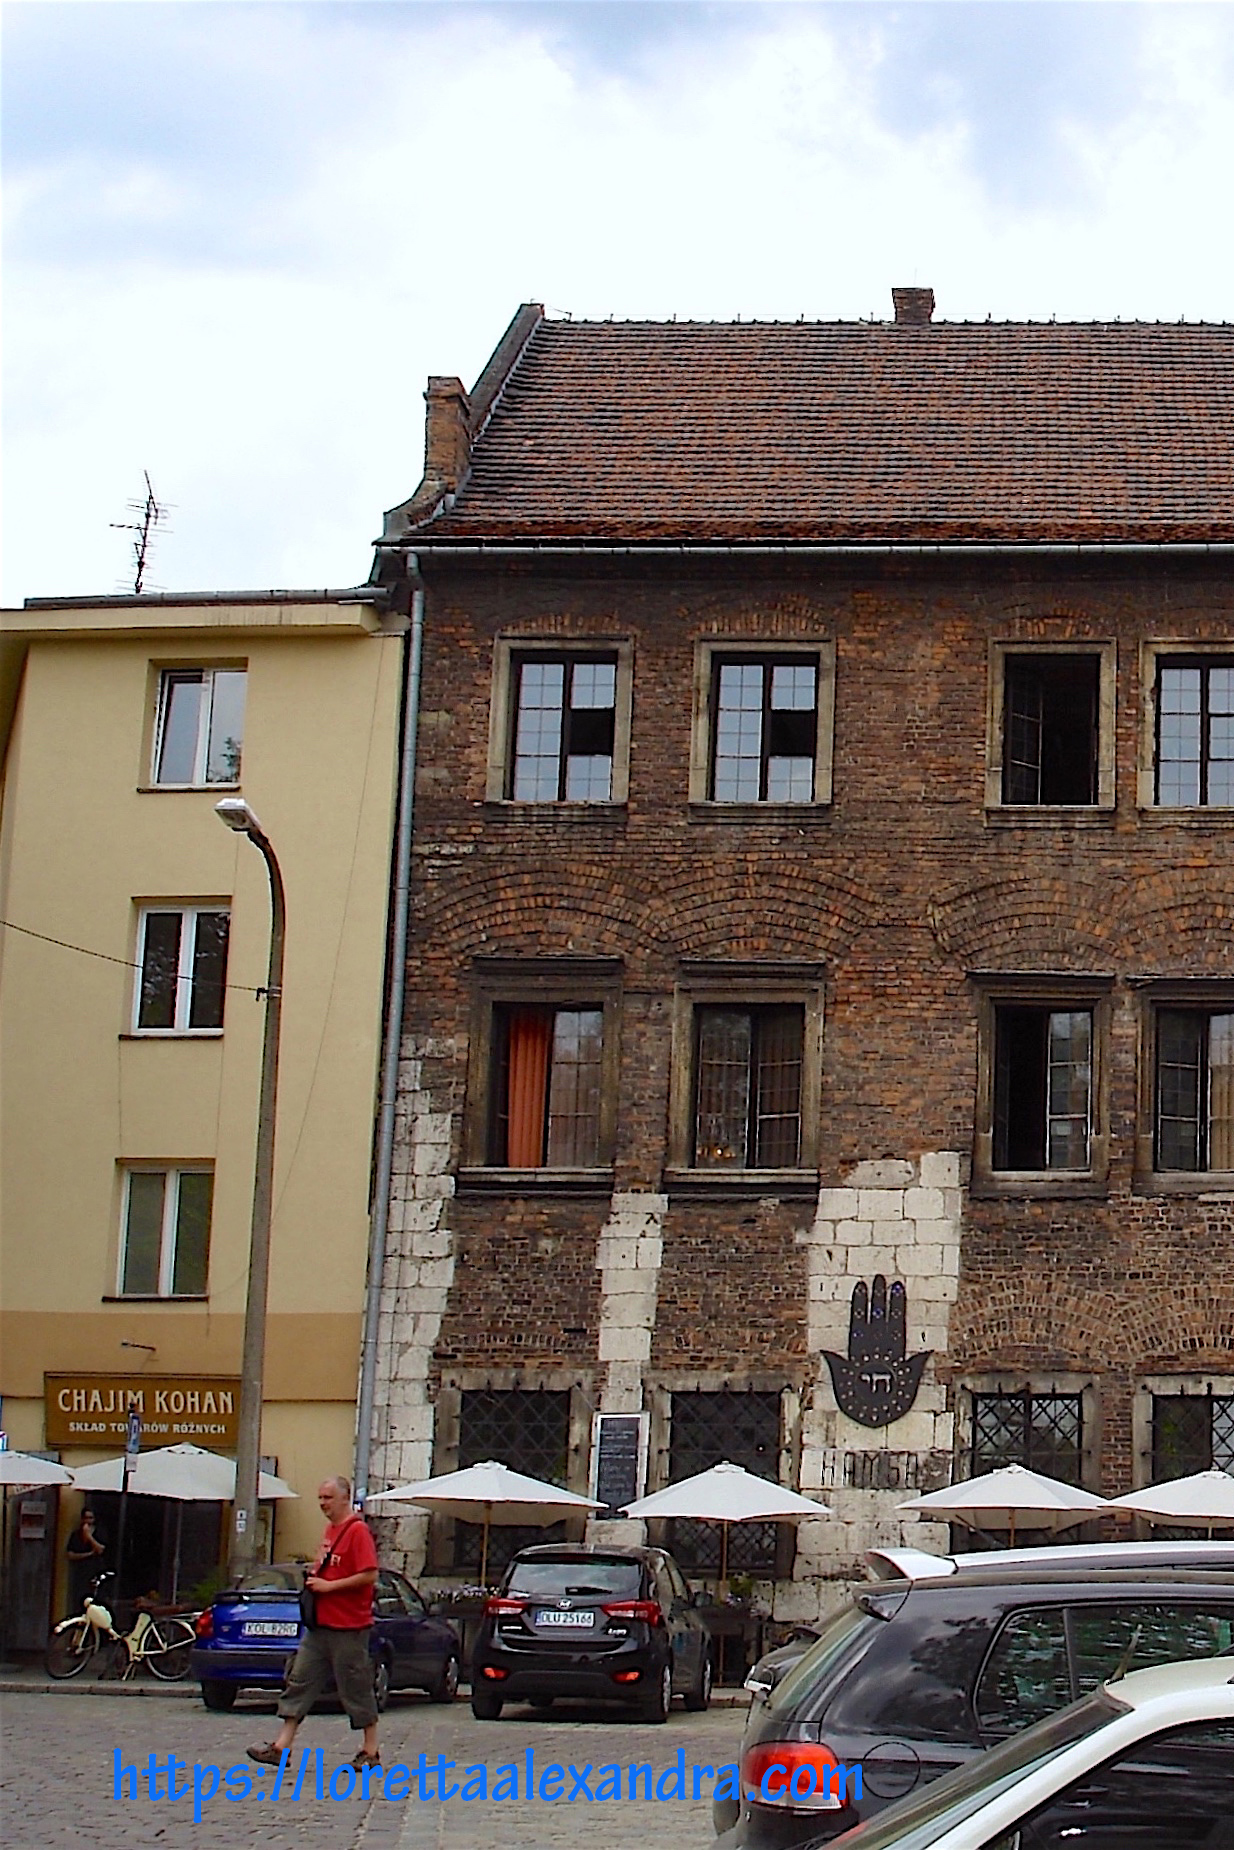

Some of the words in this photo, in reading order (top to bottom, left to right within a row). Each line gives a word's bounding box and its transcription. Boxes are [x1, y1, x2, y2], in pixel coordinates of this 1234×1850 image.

[58, 1389, 145, 1412] CHAJIM
[155, 1391, 233, 1414] KOHAN
[69, 1422, 106, 1432] SKŁAD
[110, 1421, 169, 1433] TORÓW
[173, 1421, 226, 1434] RÓŻNYCH
